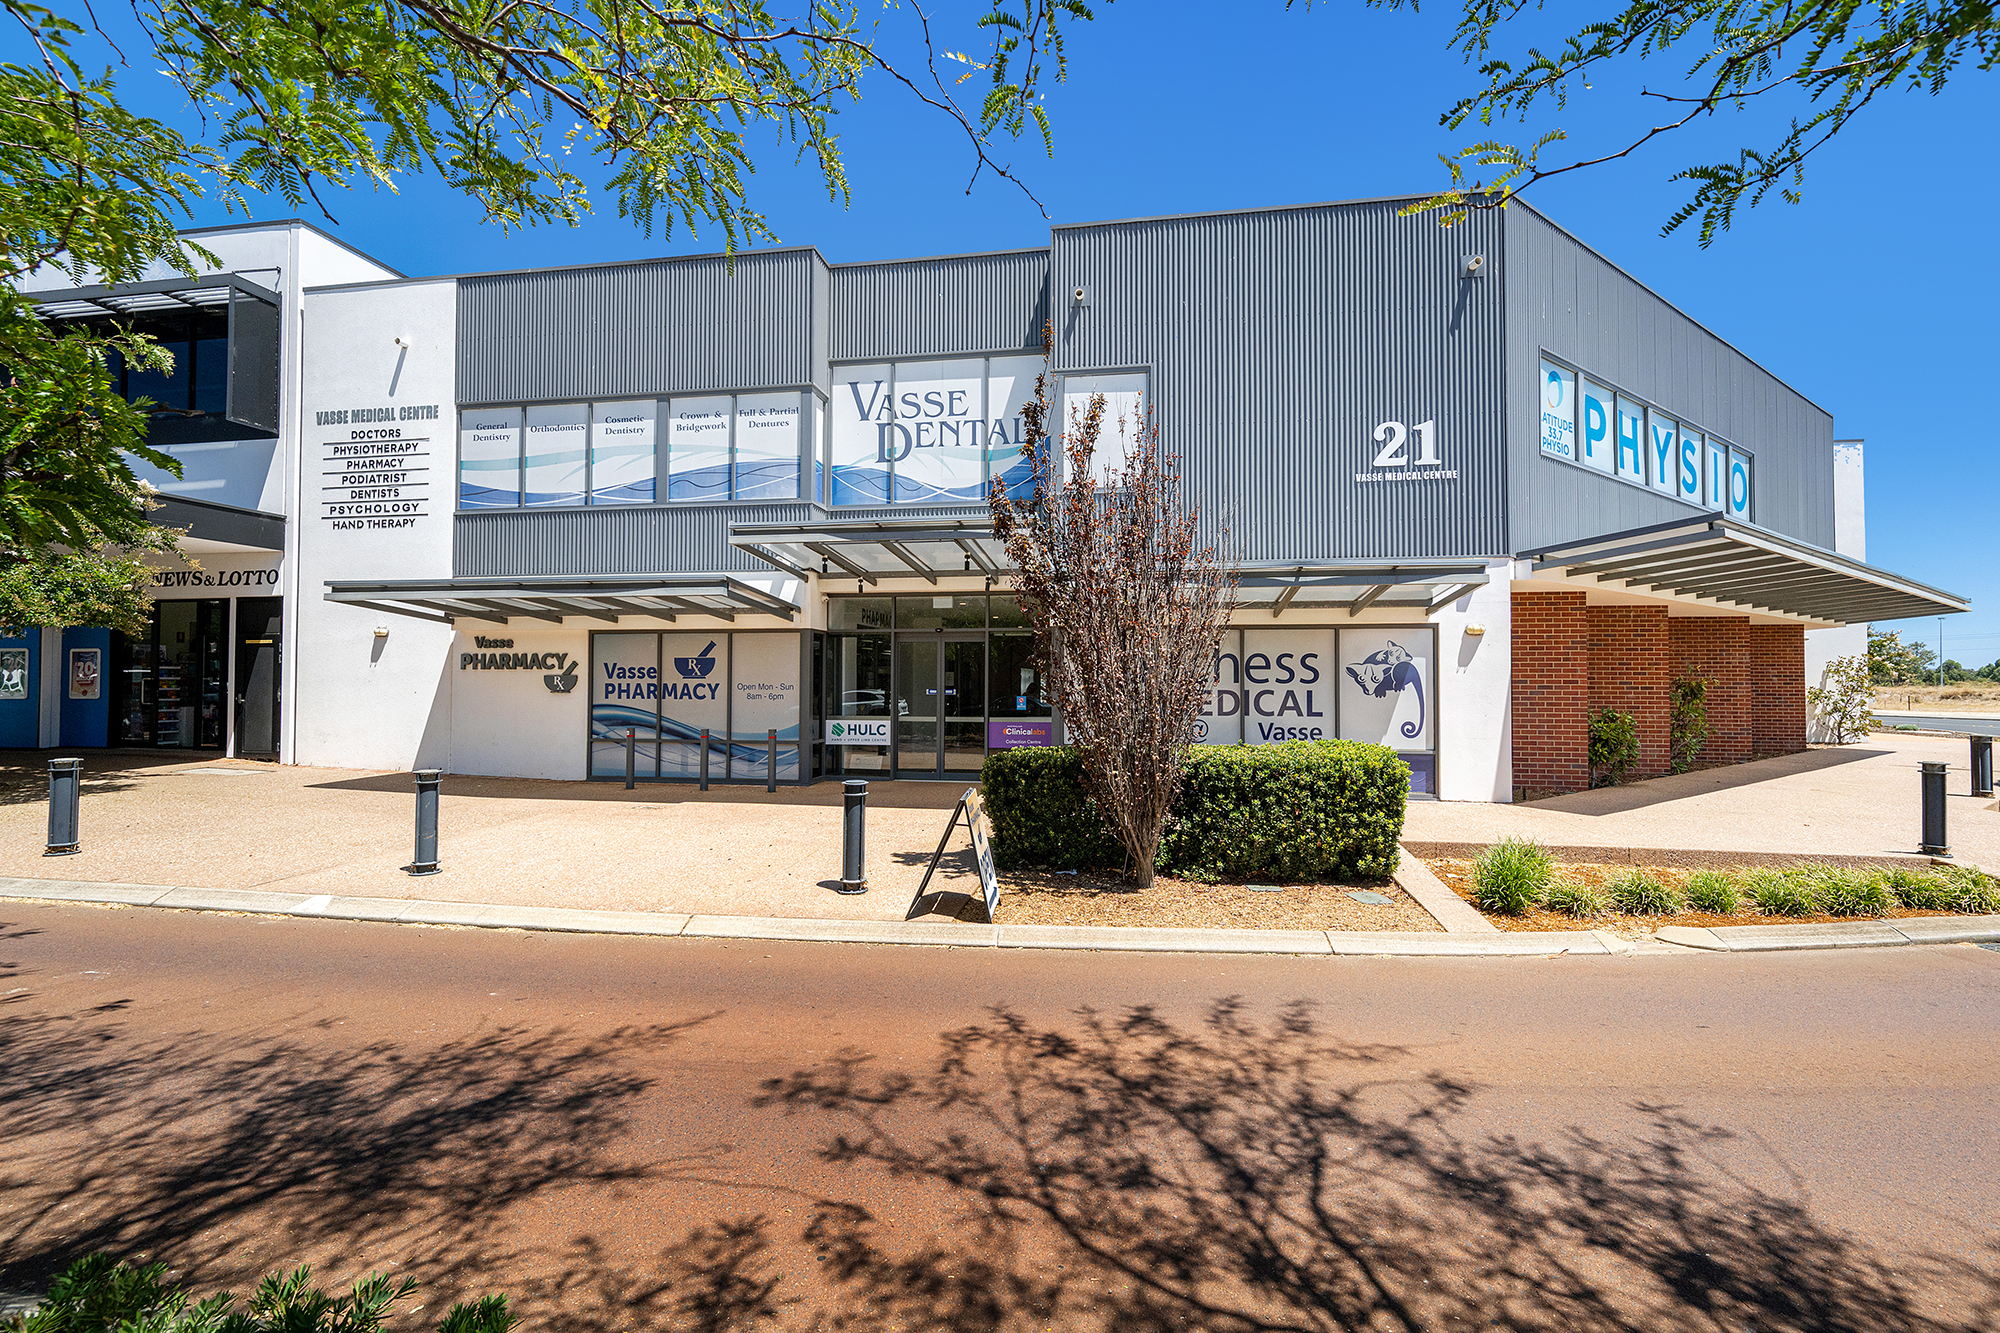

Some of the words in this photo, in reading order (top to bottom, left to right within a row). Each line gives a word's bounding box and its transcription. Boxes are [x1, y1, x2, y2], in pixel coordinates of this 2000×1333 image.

[847, 380, 969, 422] VASSE
[316, 410, 348, 426] VASSE
[351, 407, 395, 424] MEDICAL
[399, 405, 439, 421] CENTRE
[680, 411, 709, 421] Crown
[714, 410, 722, 419] &
[738, 408, 756, 417] Full
[758, 408, 767, 416] &
[769, 406, 800, 416] Partial
[605, 415, 645, 424] Cosmetic
[748, 418, 790, 429] Dentures
[1541, 411, 1573, 433] ATITUDE
[475, 422, 508, 431] General
[530, 423, 586, 433] Orthodontics
[604, 425, 646, 437] Dentistry
[676, 421, 727, 433] Bridgework
[351, 428, 401, 440] DOCTORS
[472, 432, 511, 444] Dentistry
[1548, 426, 1563, 441] 33.7
[875, 417, 1028, 463] DENTAL
[1373, 419, 1442, 467] 21
[1542, 436, 1570, 456] PHYSIO
[333, 442, 419, 456] PHYSIOTHERAPY
[1584, 394, 1747, 513] PHYSIO
[347, 458, 405, 470] PHARMACY
[342, 473, 407, 485] PODIATRIST
[1355, 472, 1383, 482] VASSE
[1385, 471, 1422, 481] MEDICAL
[1423, 470, 1458, 480] CENTRE
[350, 488, 400, 499] DENTISTS
[329, 503, 420, 515] PSYCHOLOGY
[332, 520, 364, 530] HAND
[367, 518, 416, 529] THERAPY
[474, 636, 514, 649] Vasse
[460, 652, 568, 671] PHARMACY
[604, 662, 658, 679] Vasse
[604, 682, 720, 700] PHARMACY
[737, 683, 756, 692] Open
[758, 683, 774, 691] Mon
[768, 692, 784, 702] 6pm
[1198, 689, 1323, 717] EDICAL
[847, 724, 887, 736] HULC
[1258, 722, 1323, 741] Vasse
